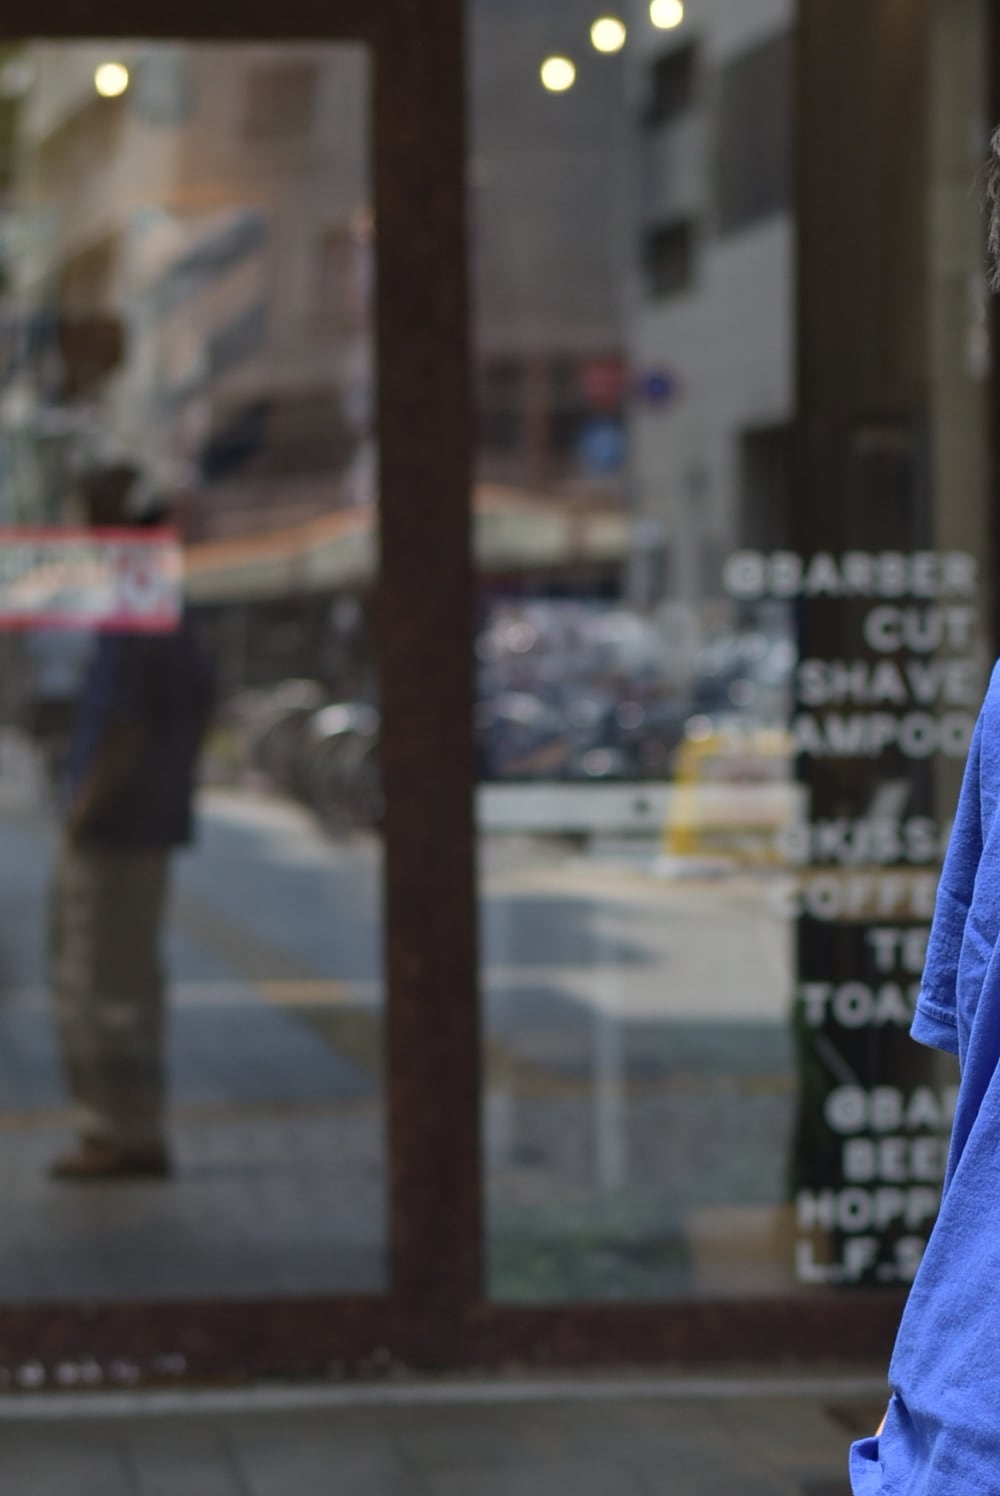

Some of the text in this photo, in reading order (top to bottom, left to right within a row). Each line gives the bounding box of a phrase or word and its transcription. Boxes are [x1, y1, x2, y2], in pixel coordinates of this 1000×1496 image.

[863, 605, 978, 652] CUT
[800, 658, 979, 706] SHAVE
[867, 926, 927, 974] TE
[843, 1136, 948, 1183] BEE
[796, 1186, 940, 1233] HOPP
